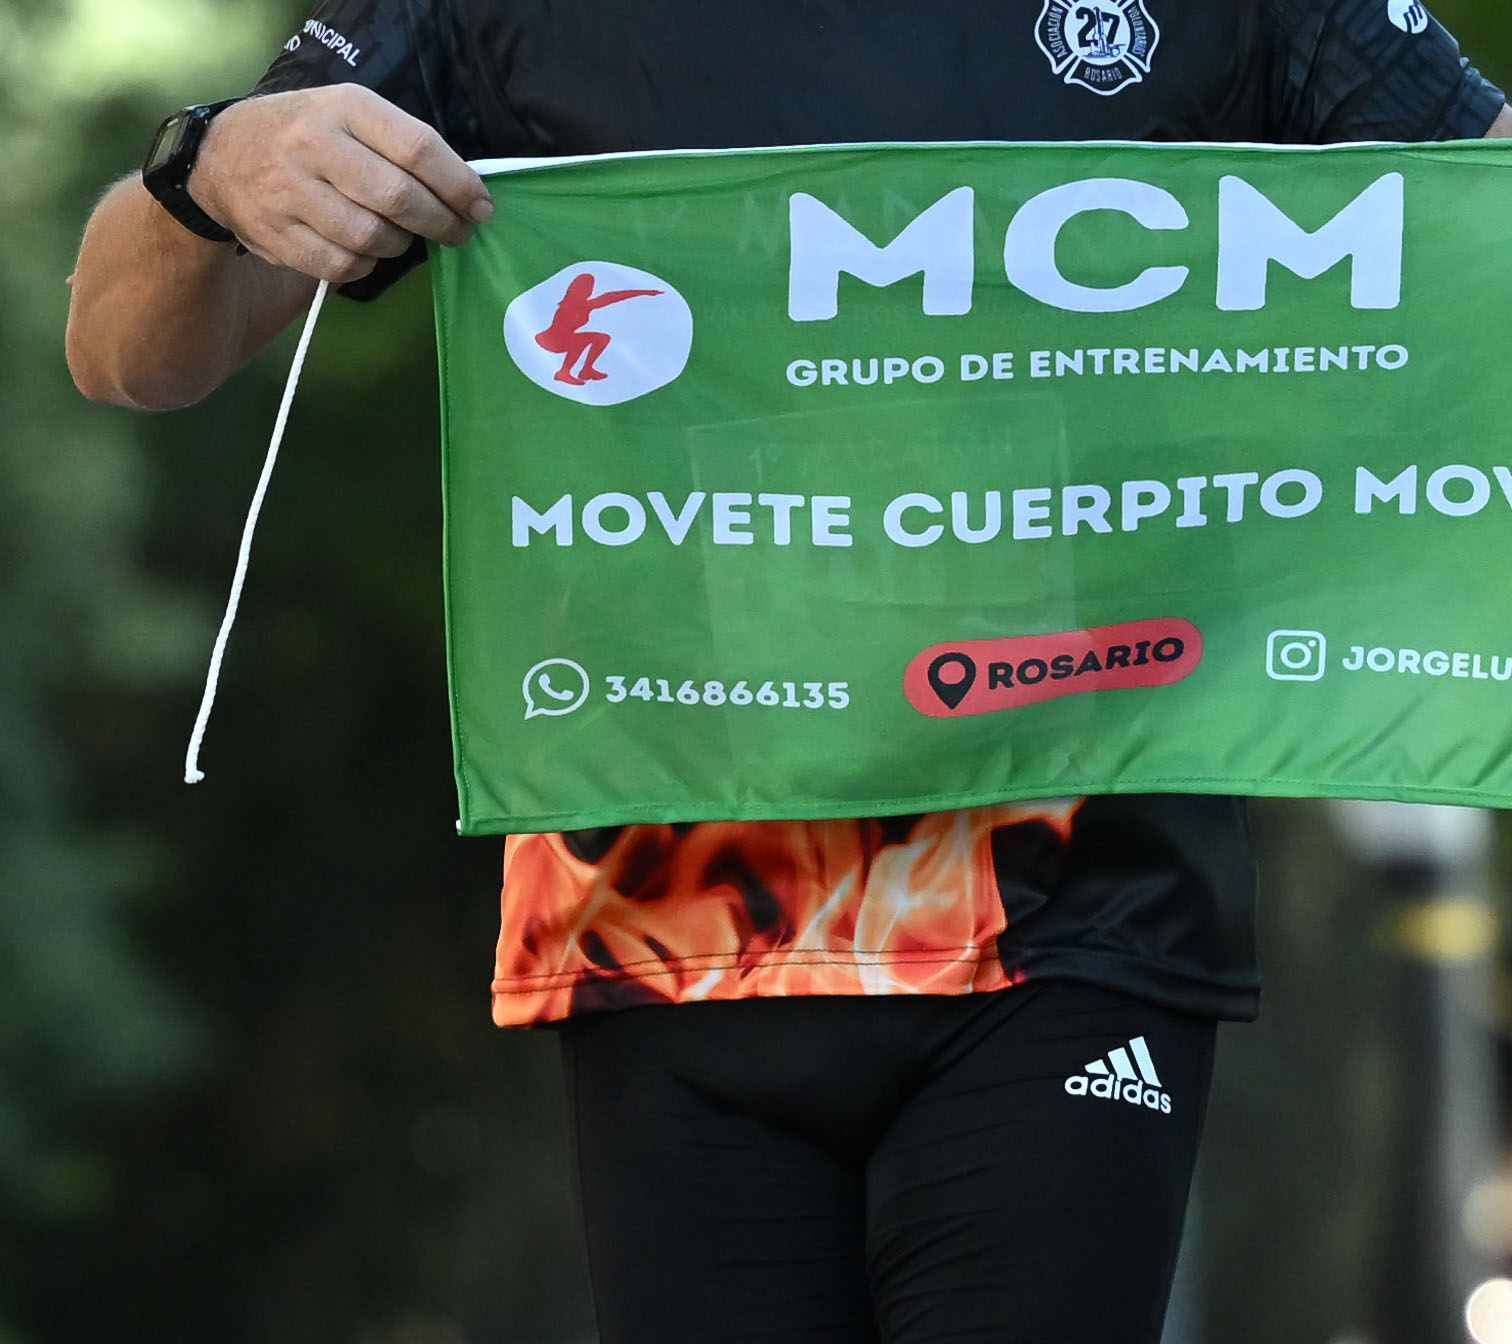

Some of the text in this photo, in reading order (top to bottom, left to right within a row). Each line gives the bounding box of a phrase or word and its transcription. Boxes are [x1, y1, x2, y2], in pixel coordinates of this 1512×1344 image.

[303, 19, 360, 67] UNICIPAL
[1075, 6, 1121, 49] 27
[1084, 66, 1123, 83] ROSARIO
[788, 172, 1404, 321] MCM
[786, 344, 1409, 386] GRUPO DE ENTRENAMIENTO
[511, 491, 854, 548] MOVETE
[883, 468, 1323, 548] CUERPITO
[988, 636, 1185, 691] ROSARIO
[604, 675, 851, 710] 3416866135
[1064, 1074, 1171, 1114] adidas
